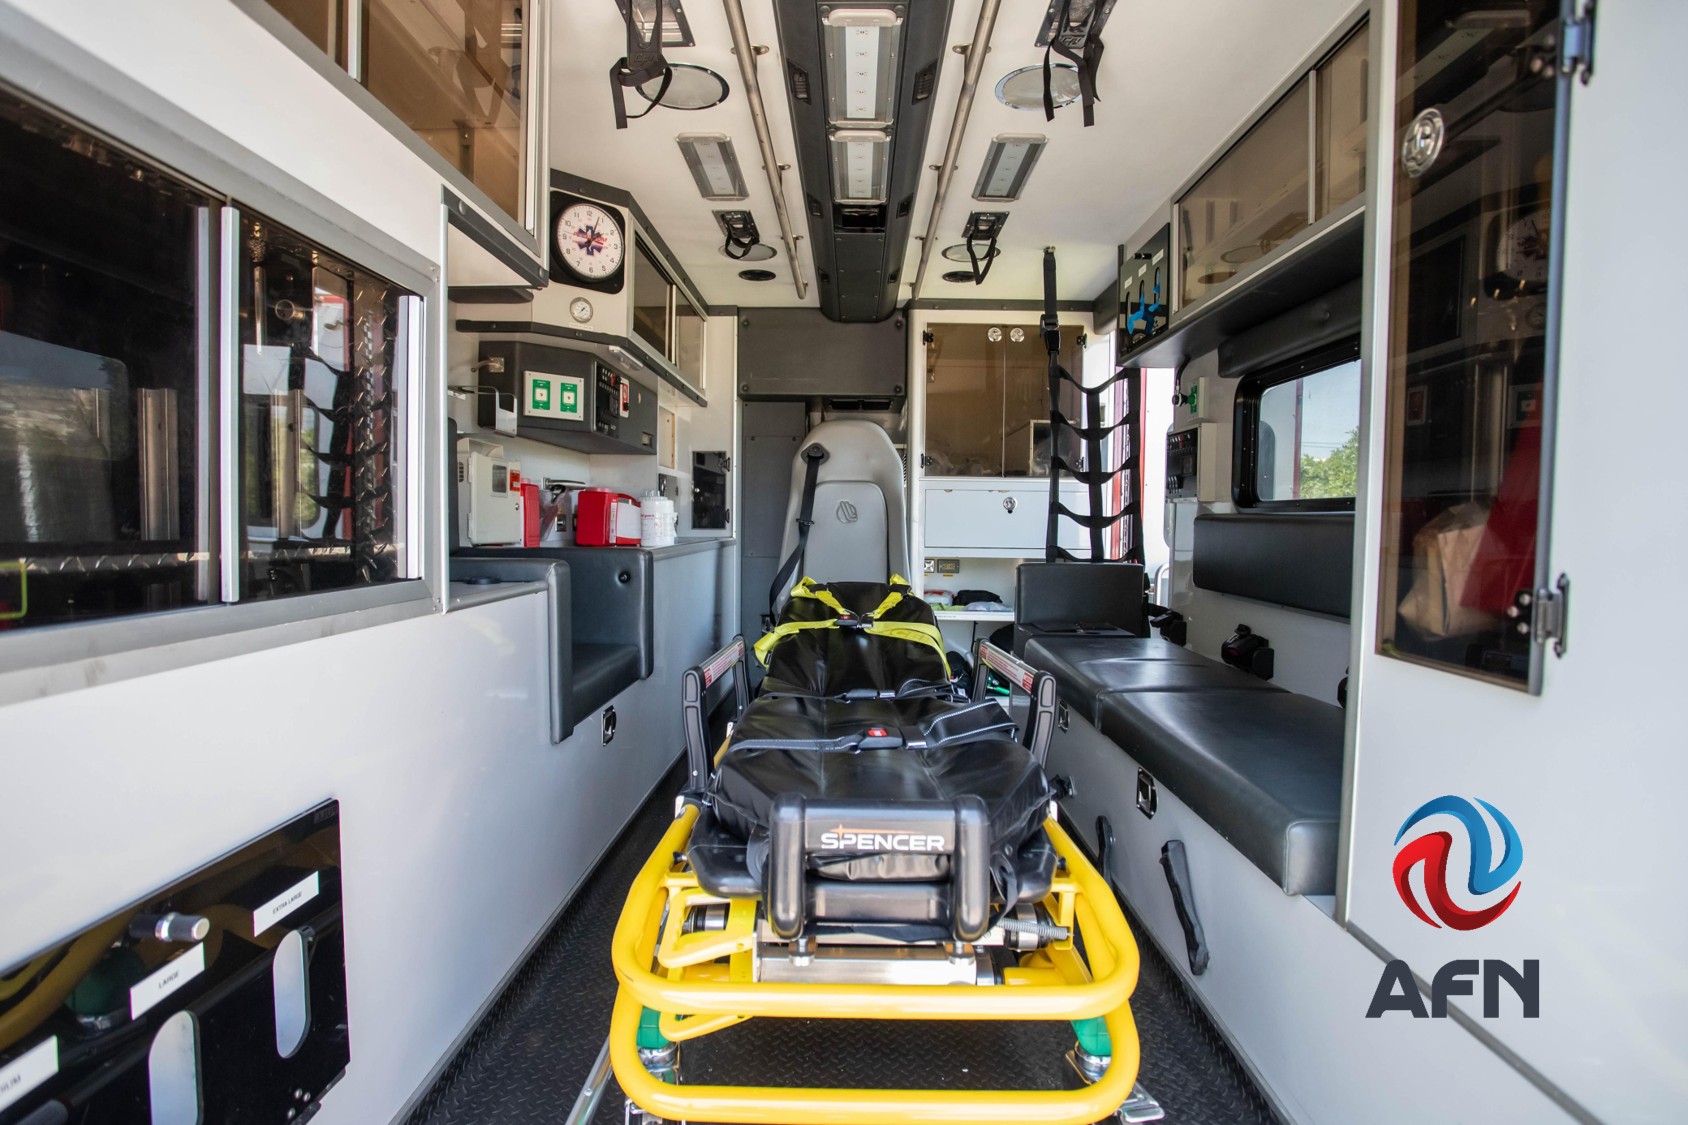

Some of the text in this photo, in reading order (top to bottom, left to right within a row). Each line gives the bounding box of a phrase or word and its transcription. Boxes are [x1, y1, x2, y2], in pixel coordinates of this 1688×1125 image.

[821, 832, 945, 852] SPENCER
[272, 891, 302, 914] EXTRA LARGE
[158, 970, 179, 989] LARGE
